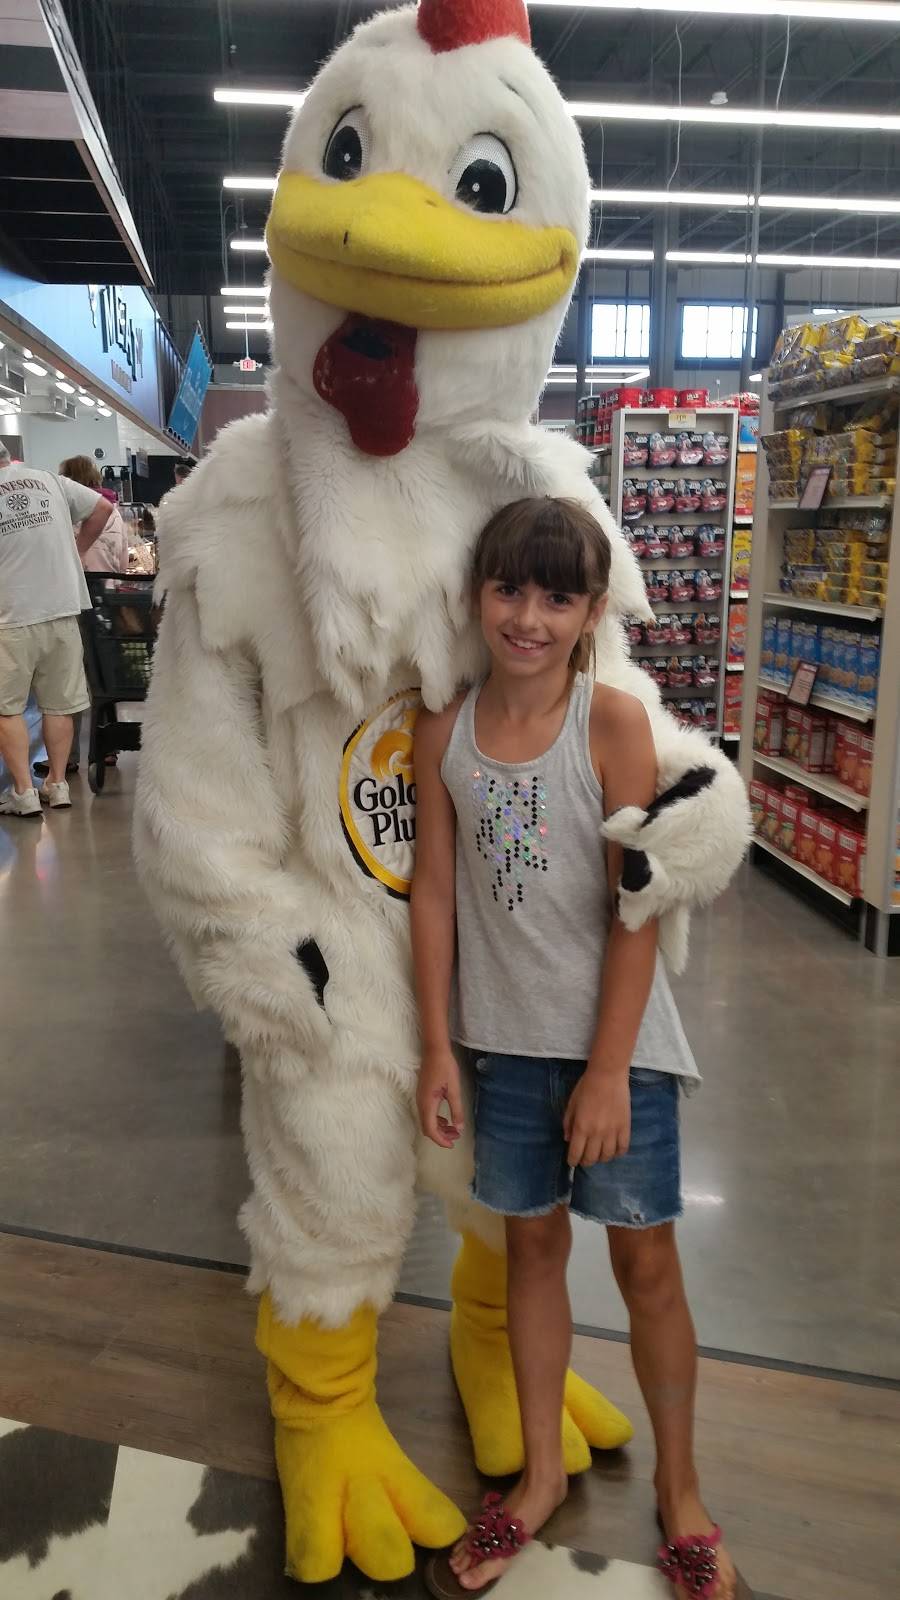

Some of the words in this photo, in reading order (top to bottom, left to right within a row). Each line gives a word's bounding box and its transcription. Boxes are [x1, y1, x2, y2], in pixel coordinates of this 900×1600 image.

[0, 479, 51, 495] NESOTA
[40, 499, 49, 508] 07
[0, 515, 53, 534] HAMPIONSHIPS
